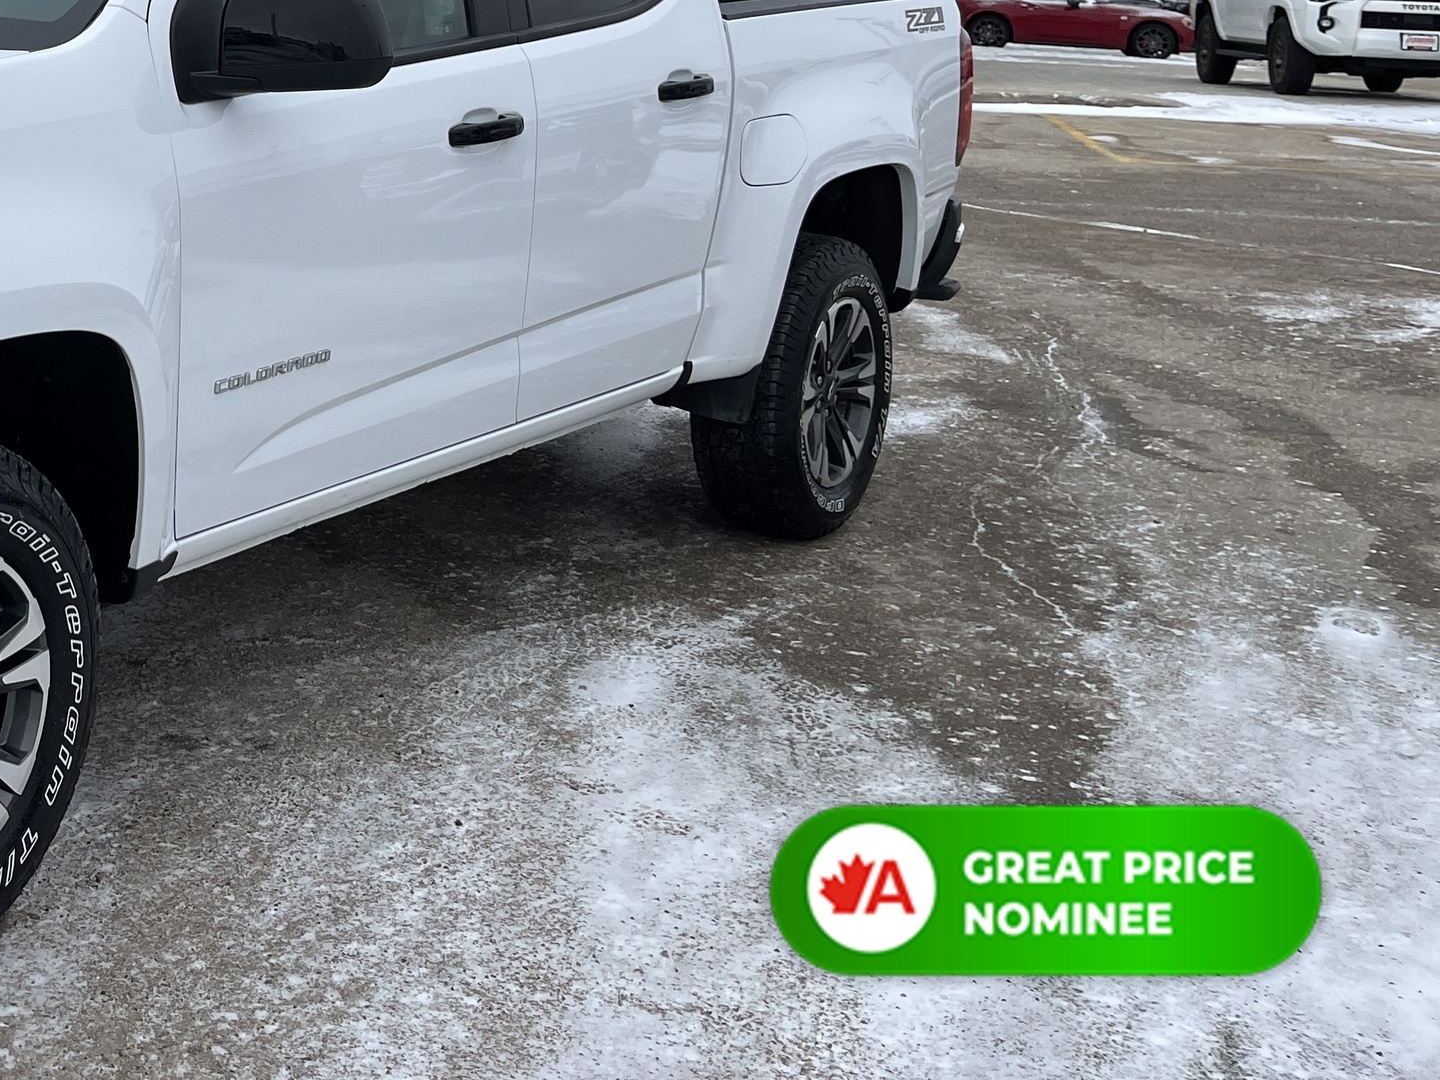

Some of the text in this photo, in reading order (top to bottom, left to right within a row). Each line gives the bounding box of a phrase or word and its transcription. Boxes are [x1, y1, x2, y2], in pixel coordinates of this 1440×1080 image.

[905, 6, 945, 32] Z71
[1402, 4, 1440, 12] TOYOTA
[213, 348, 331, 395] COLORADO
